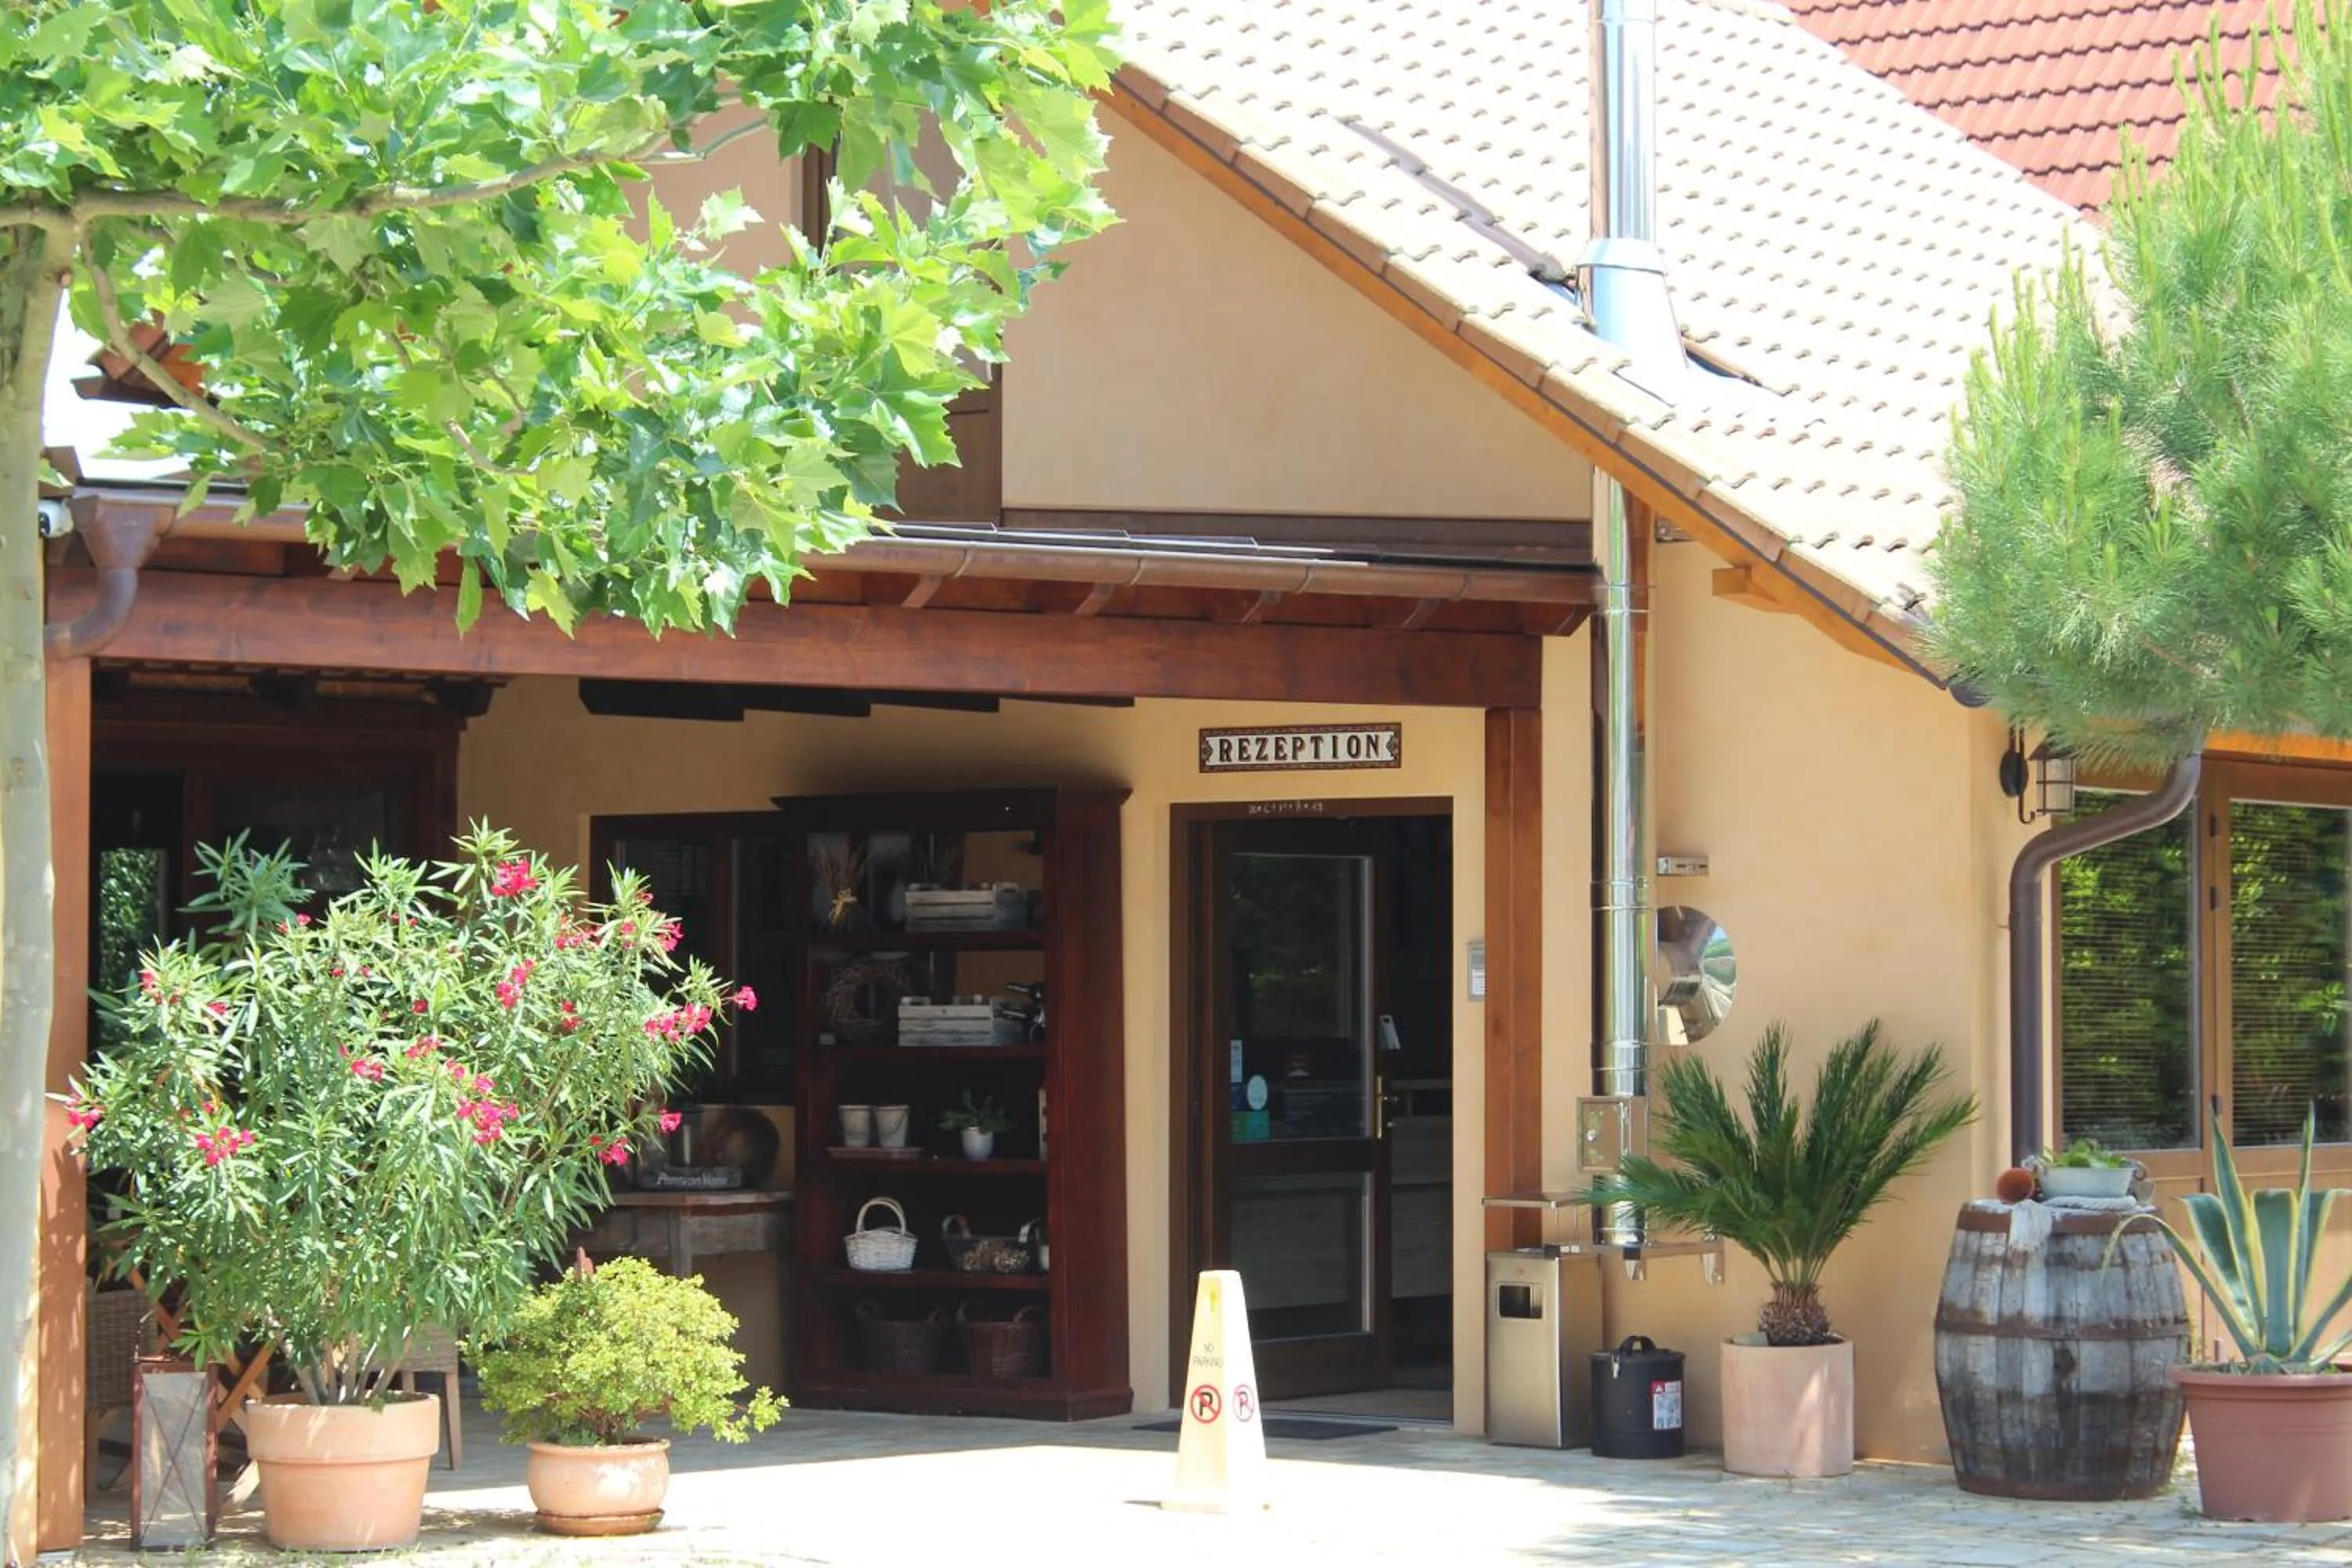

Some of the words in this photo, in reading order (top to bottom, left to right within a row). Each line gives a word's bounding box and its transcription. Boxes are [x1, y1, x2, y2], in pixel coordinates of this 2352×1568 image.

[1218, 735, 1381, 762] REZEPTION
[1203, 1342, 1215, 1354] NO
[1192, 1356, 1224, 1368] PARKING
